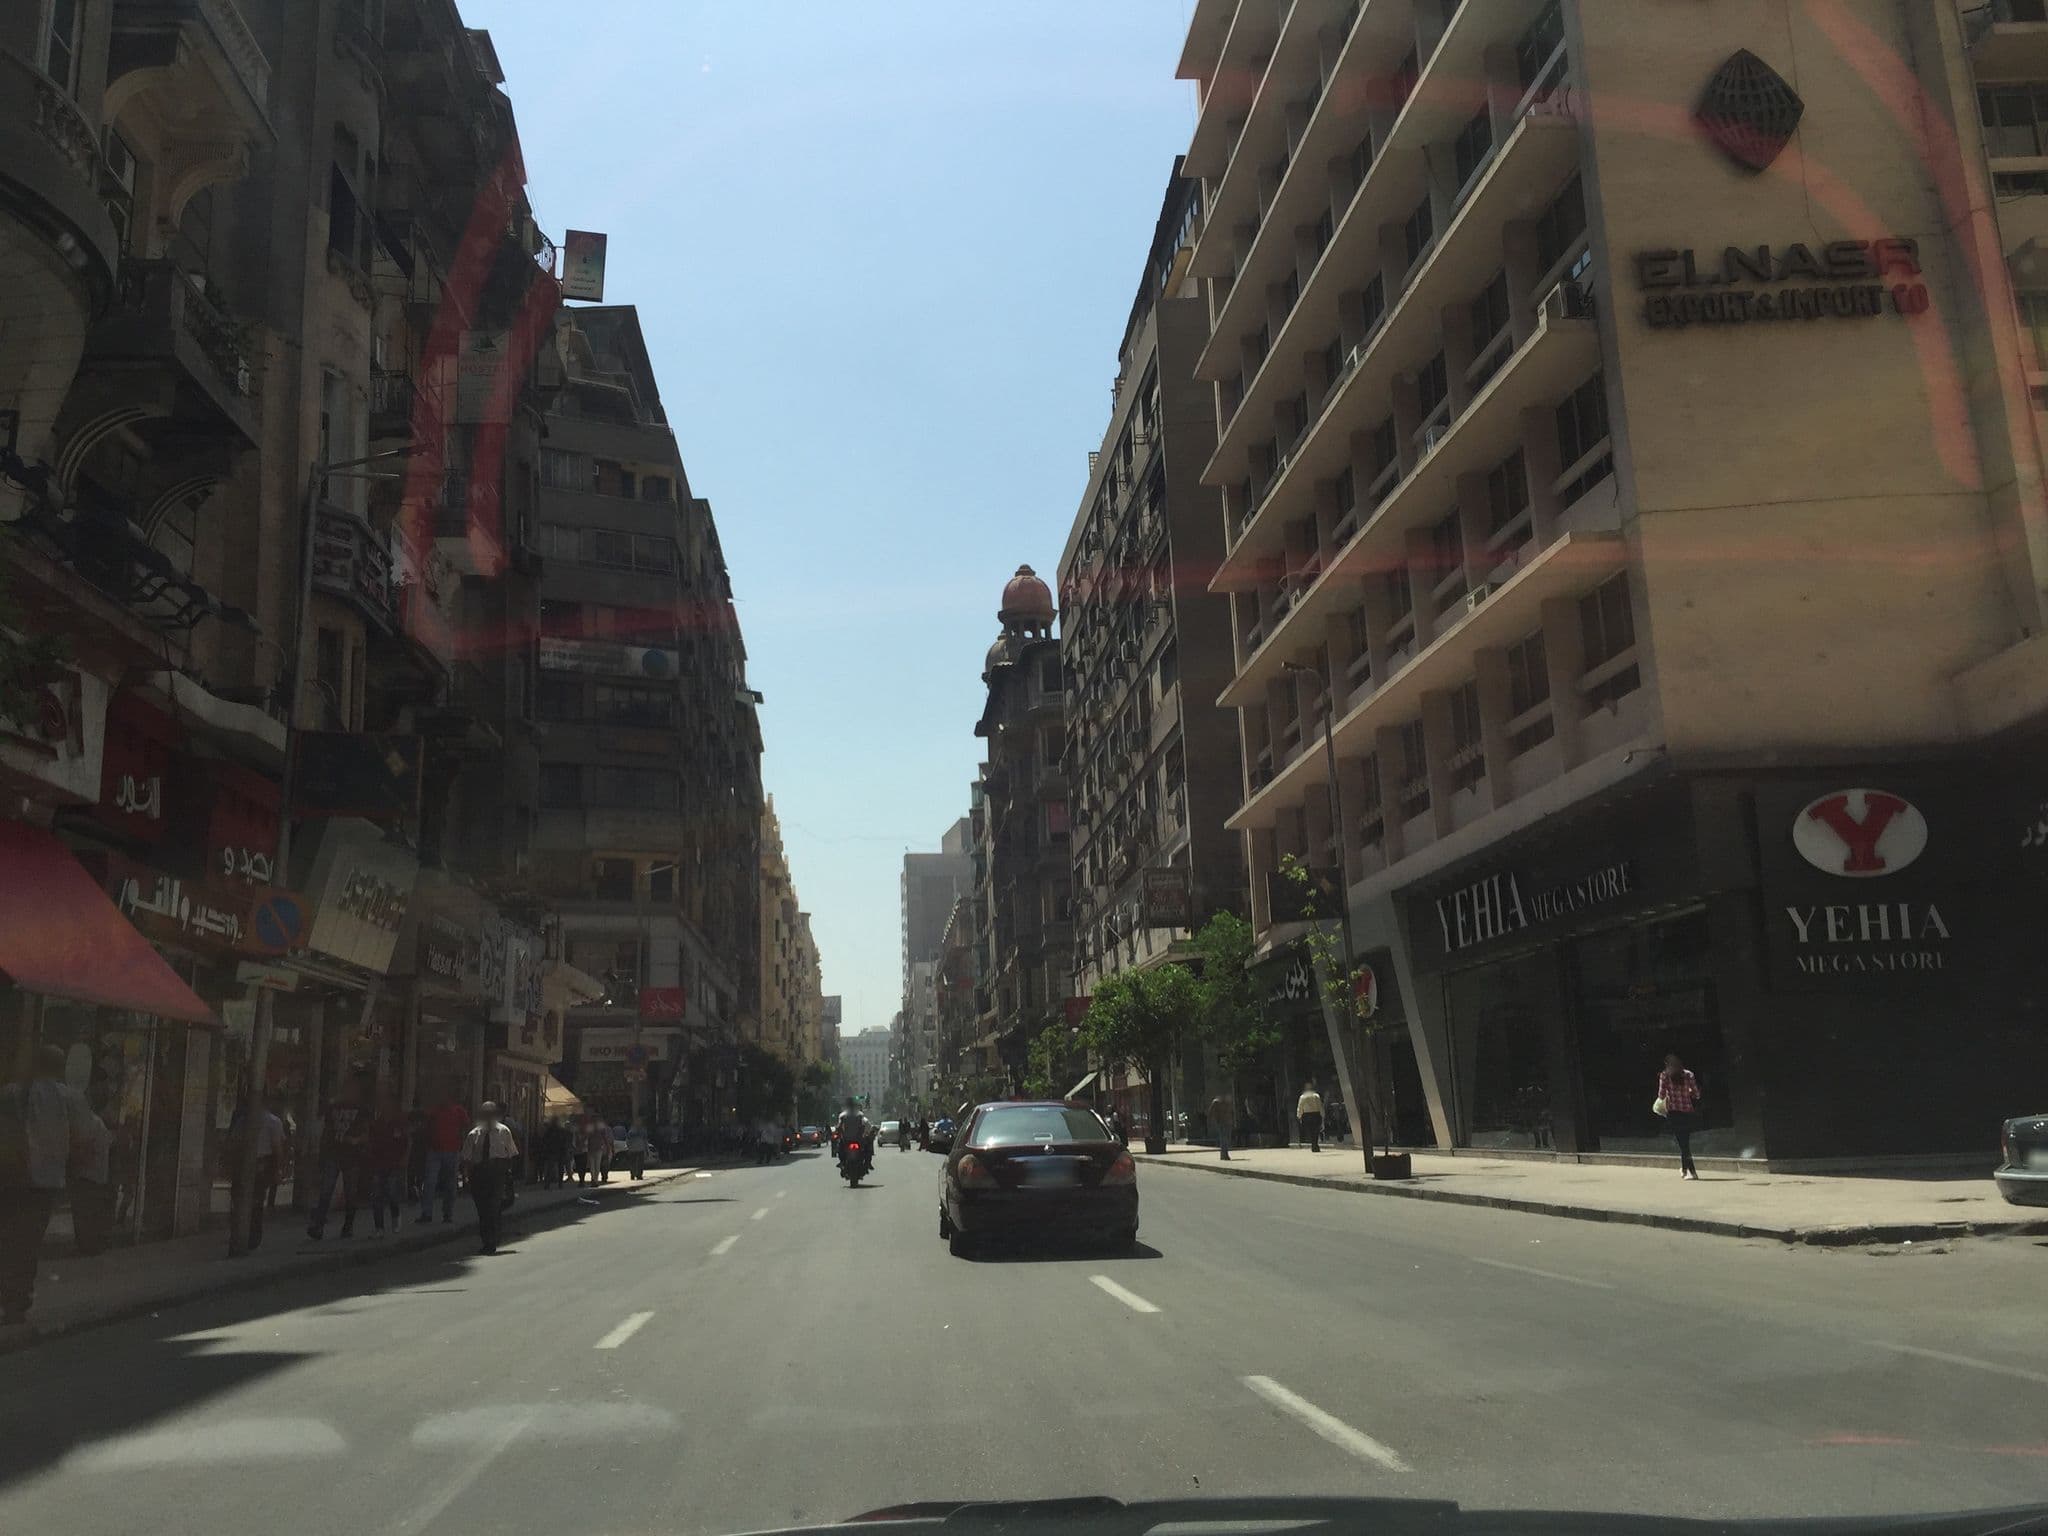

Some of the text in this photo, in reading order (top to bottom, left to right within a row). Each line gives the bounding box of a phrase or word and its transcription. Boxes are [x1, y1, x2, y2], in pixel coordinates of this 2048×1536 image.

[1808, 793, 1908, 872] Y
[1436, 872, 1528, 952] YEHIA
[1786, 903, 1951, 942] YEHIA
